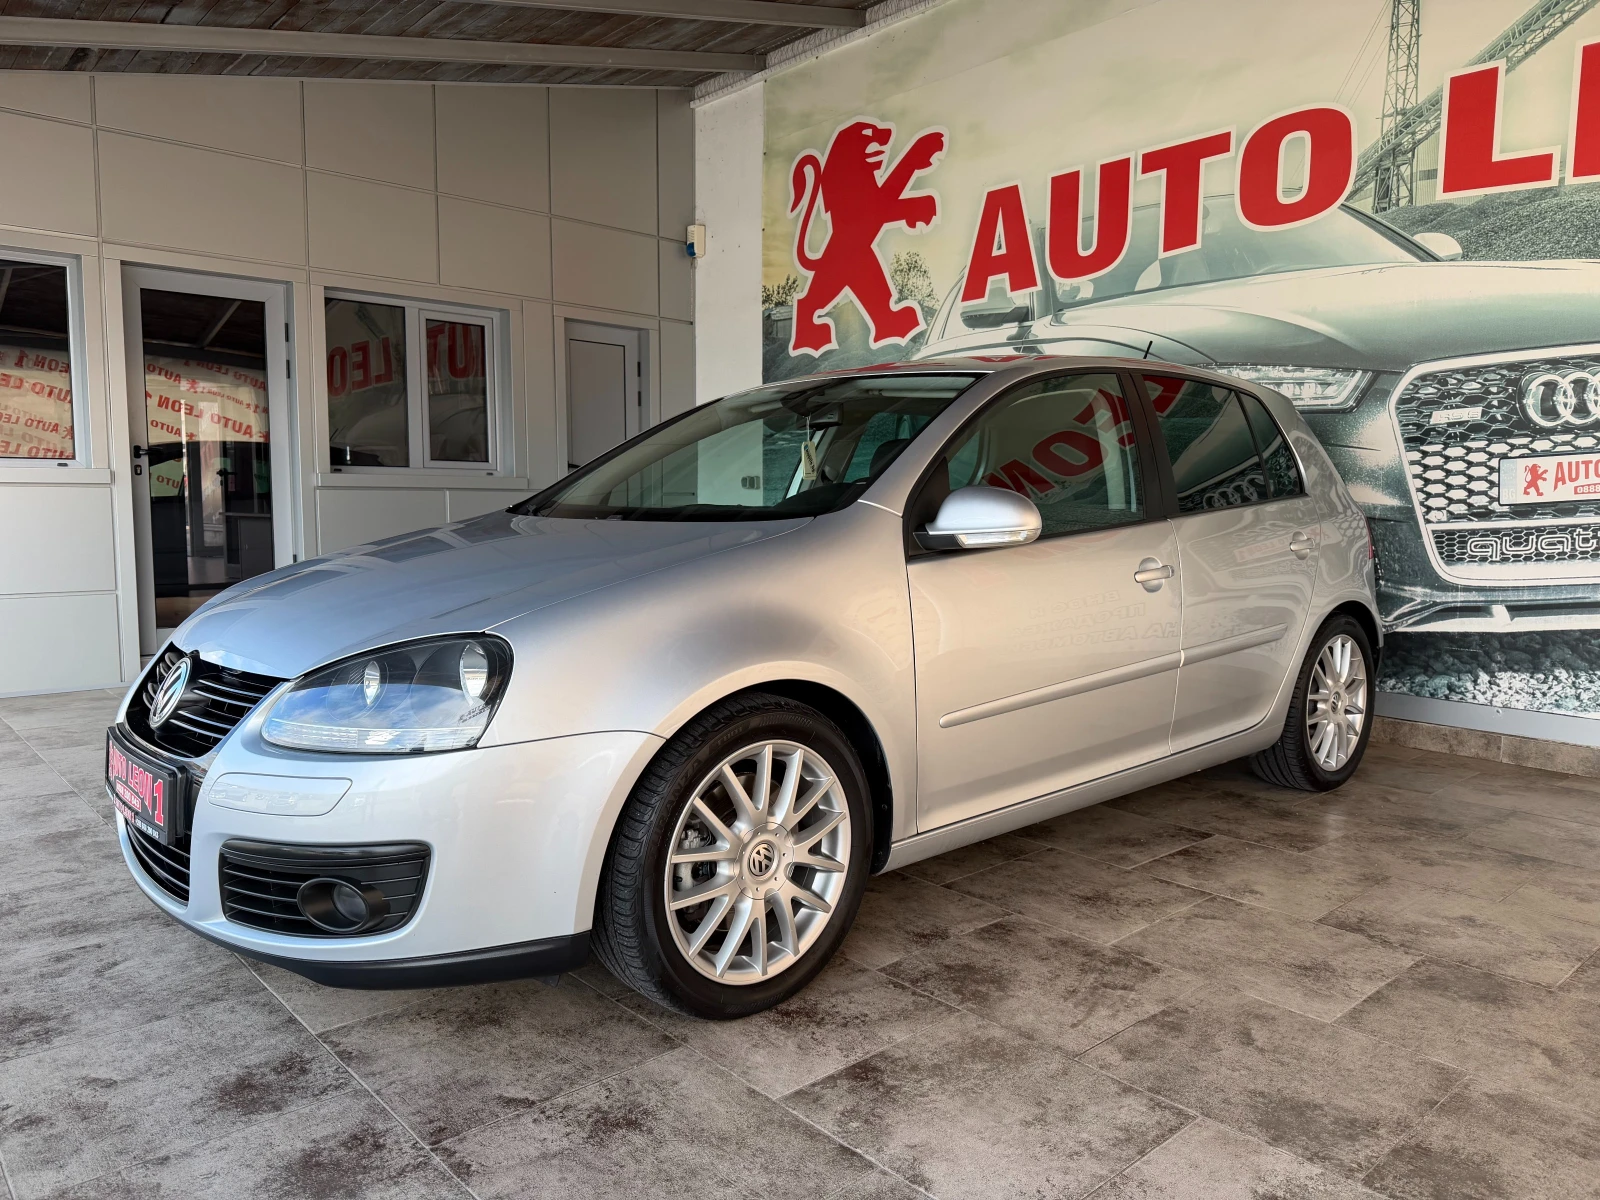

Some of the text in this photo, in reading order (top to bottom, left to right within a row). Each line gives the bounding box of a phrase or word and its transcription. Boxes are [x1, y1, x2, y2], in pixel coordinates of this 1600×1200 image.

[959, 104, 1356, 303] AUTO
[1467, 529, 1600, 561] quat
[128, 760, 153, 815] LEON
[154, 779, 164, 826] 1
